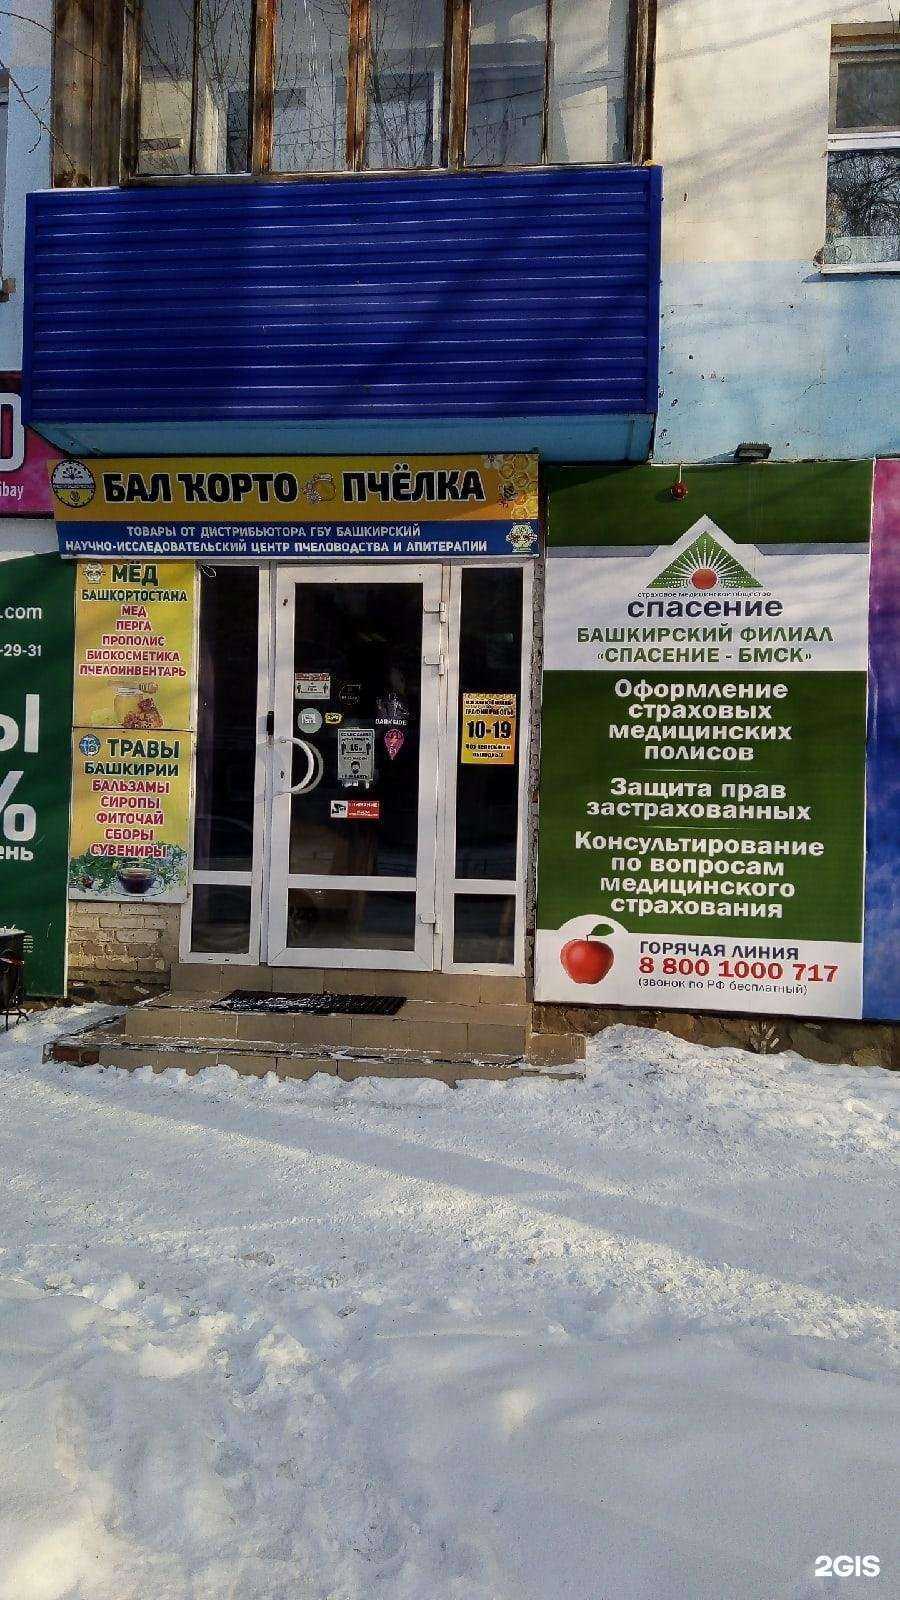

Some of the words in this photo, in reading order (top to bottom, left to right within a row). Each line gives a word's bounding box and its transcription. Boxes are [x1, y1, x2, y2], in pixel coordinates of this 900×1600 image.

[103, 473, 171, 503] БАЛ
[342, 463, 486, 502] ПЧЁЛКА
[127, 526, 176, 537] ТОВАРЫ
[181, 526, 196, 537] ОТ
[201, 526, 306, 538] ДИСТРИБЬЮТОРА
[310, 526, 332, 537] ГБУ
[337, 523, 421, 537] БАШКИРСКИЙ
[65, 539, 247, 553] НАУЧНО-ИССЛЕДОВАТЕЛЬСКИЙ
[251, 541, 290, 553] ЦЕНТР
[295, 542, 389, 554] ПЧЕЛОВОДСТВА
[394, 541, 402, 552] И
[407, 541, 487, 552] АПИТЕРАПИИ
[81, 589, 188, 602] БАШКОРТОСТАНА
[627, 600, 783, 618] спасение
[116, 620, 151, 631] ПЕРГА
[577, 623, 732, 643] БАШКИРСКИЙ
[740, 626, 833, 642] ФИЛИАЛ
[102, 635, 166, 647] ПРОПОЛИС
[86, 650, 180, 662] БИОКОСМЕТИКА
[597, 648, 719, 663] «СПАСЕНИЕ
[738, 647, 811, 663] БМСК»
[79, 664, 187, 677] ПЧЕЛОИНВЕНТАРЬ
[614, 678, 789, 701] Оформление
[628, 703, 772, 721] страховых
[467, 720, 512, 739] 10-19
[608, 724, 792, 742] медицинских
[107, 737, 179, 759] ТРАВЫ
[644, 745, 754, 761] полисов
[84, 762, 179, 776] БАШКИРИИ
[92, 779, 169, 793] БАЛЬЗАМЫ
[610, 777, 712, 799] Защита
[721, 782, 786, 801] прав
[100, 795, 160, 809] СИРОПЫ
[586, 801, 811, 821] застрахованных
[95, 810, 163, 825] ФИТОЧАЙ
[105, 828, 153, 841] СБОРЫ
[575, 830, 825, 856] Консультирование
[90, 843, 166, 858] СУВЕНИРЫ
[611, 857, 642, 871] по
[650, 858, 784, 877] вопросам
[600, 877, 795, 897] медицинского
[611, 898, 783, 918] страхования
[640, 940, 725, 957] ГОРЯЧАЯ
[731, 945, 799, 960] ЛИНИЯ
[638, 957, 655, 974] 8
[662, 957, 710, 976] 800
[718, 960, 783, 980] 1000
[792, 963, 839, 982] 717
[638, 977, 686, 989] (звонок
[688, 981, 703, 989] по
[707, 980, 725, 991] РФ
[729, 981, 808, 995] бесплатный)
